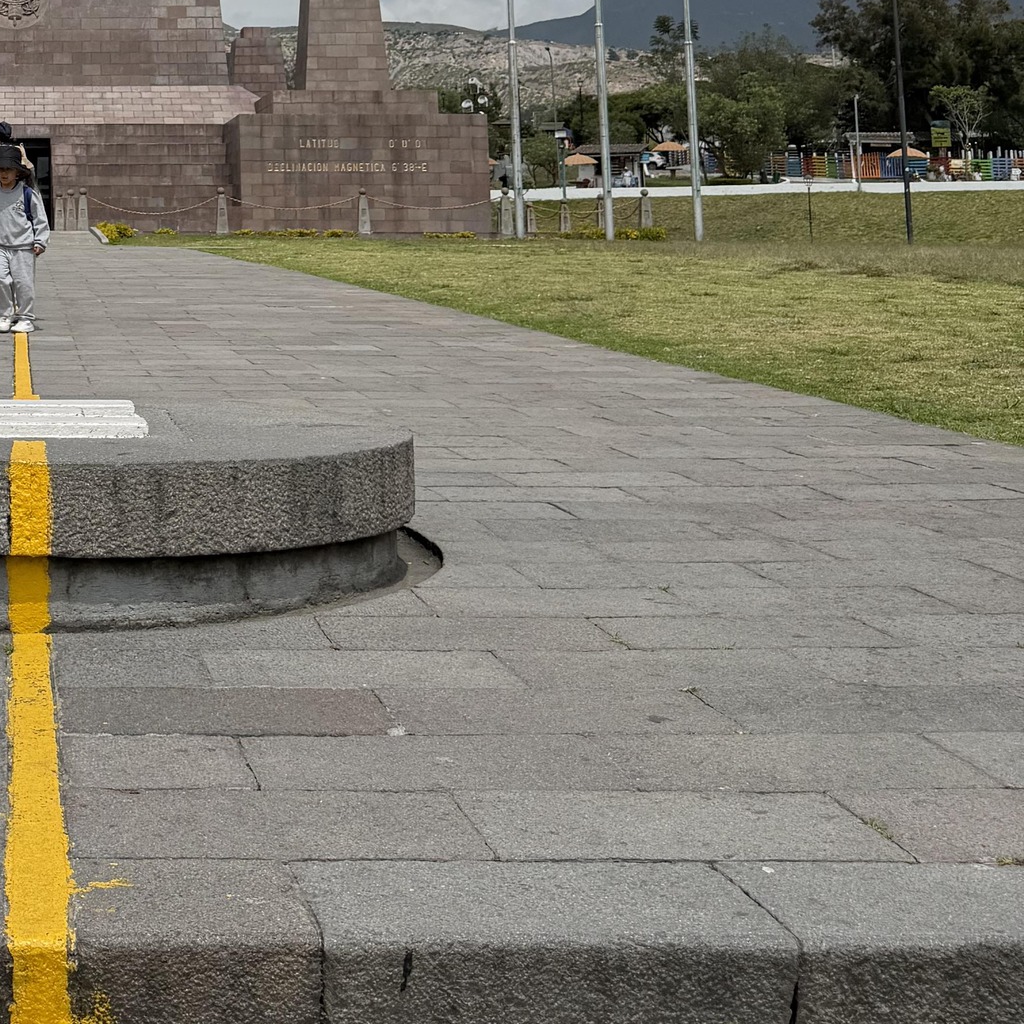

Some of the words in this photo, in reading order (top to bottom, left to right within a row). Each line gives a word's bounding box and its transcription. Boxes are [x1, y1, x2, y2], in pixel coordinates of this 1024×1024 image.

[299, 139, 339, 148] LATITUD
[267, 162, 328, 172] DECLINACION
[334, 162, 386, 172] MAGNETICA
